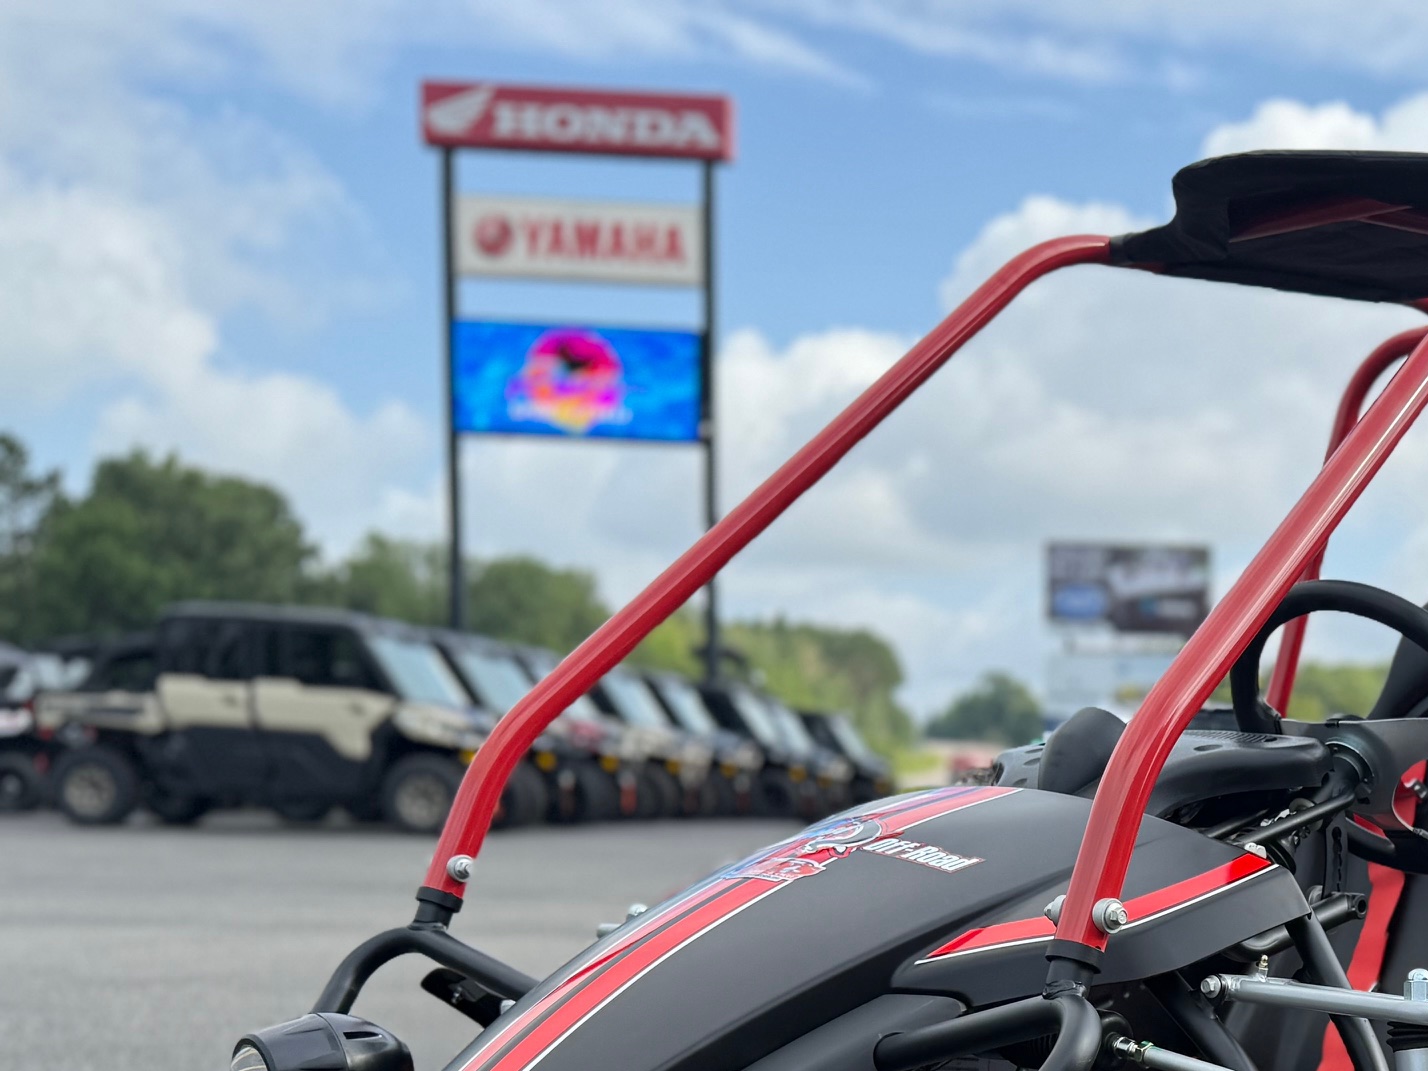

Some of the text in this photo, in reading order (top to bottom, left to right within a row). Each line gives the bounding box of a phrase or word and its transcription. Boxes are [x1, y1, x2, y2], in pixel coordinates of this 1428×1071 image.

[494, 100, 722, 149] HONDA
[522, 215, 685, 262] YAMAHA
[862, 837, 977, 871] Off-Road
